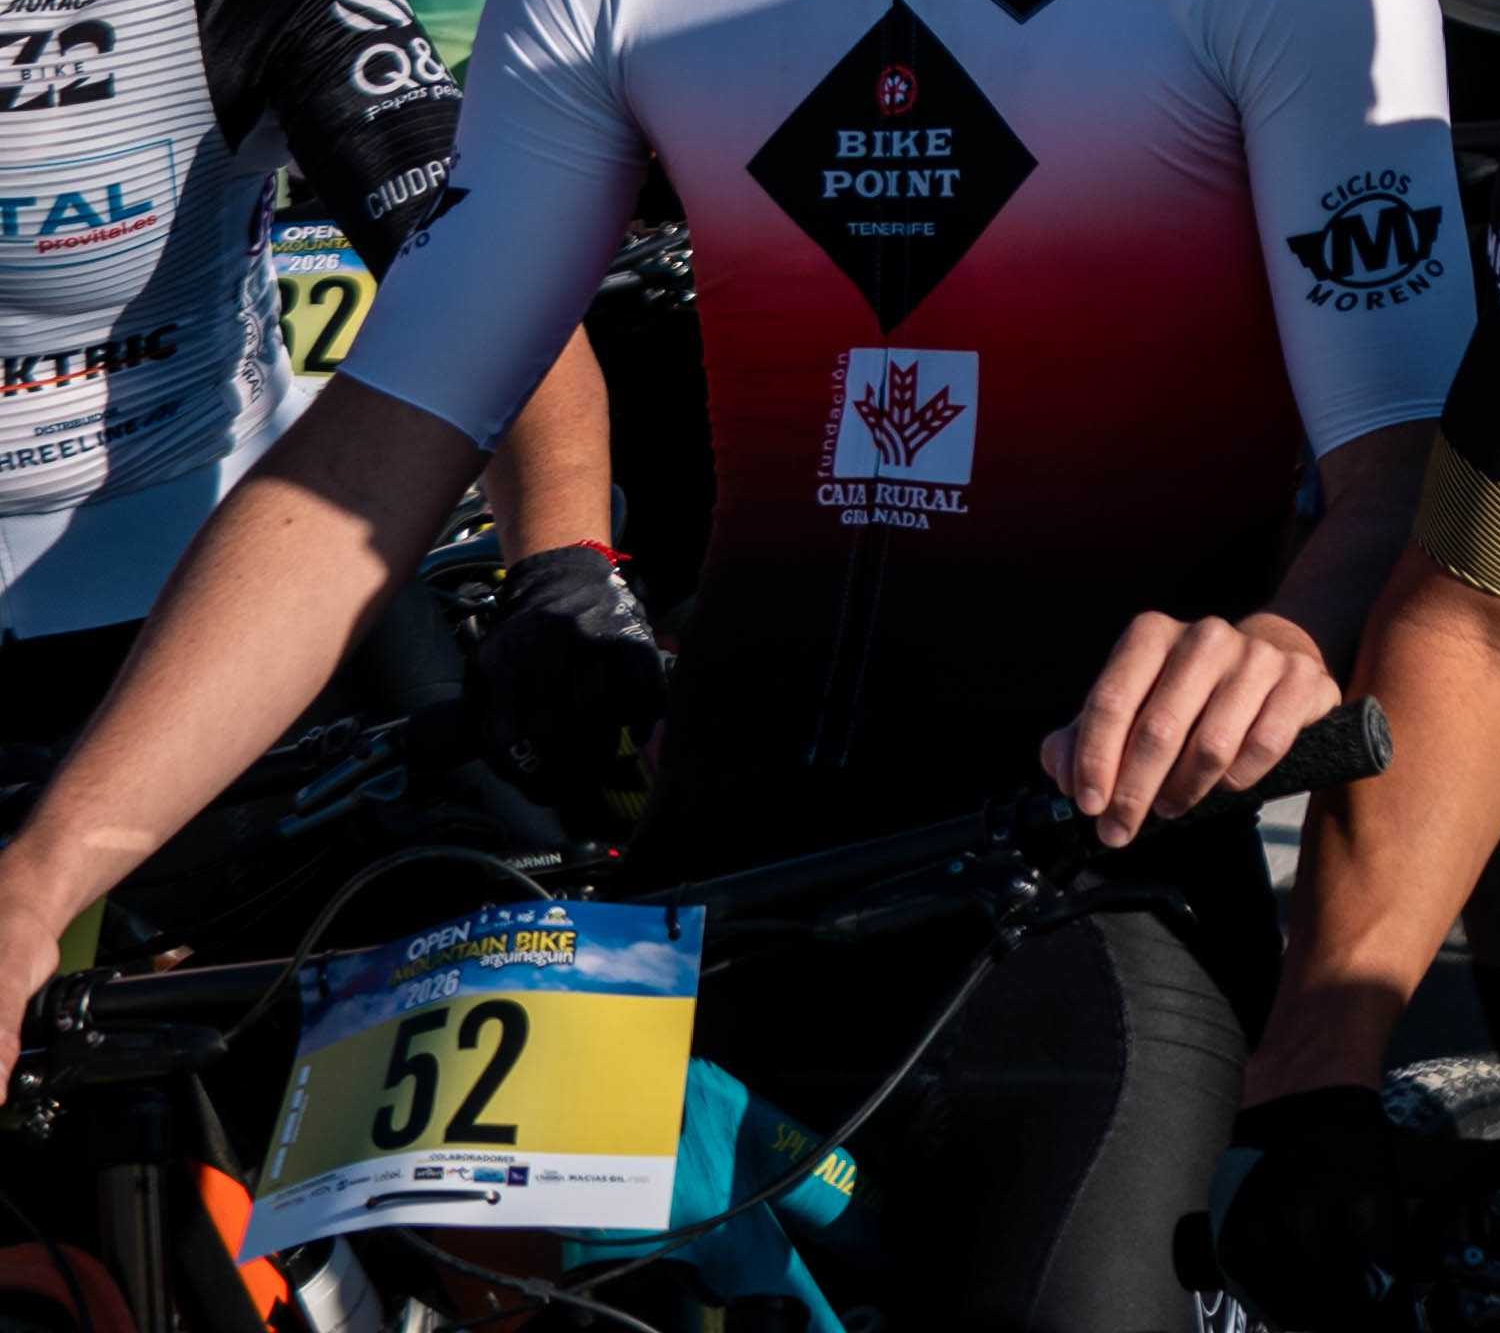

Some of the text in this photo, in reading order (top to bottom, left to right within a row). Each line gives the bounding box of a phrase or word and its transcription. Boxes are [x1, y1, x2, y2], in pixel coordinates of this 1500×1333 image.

[20, 61, 86, 82] BIKE
[835, 127, 953, 159] BIKE
[822, 167, 961, 200] POINT
[1320, 169, 1412, 215] CICLOS
[34, 212, 159, 256] provital.es
[281, 224, 345, 241] OPEN
[848, 220, 936, 238] TENERIFE
[287, 253, 341, 272] 2026
[1305, 259, 1445, 314] MORENO
[816, 350, 850, 479] fundación
[817, 482, 968, 515] CAJA RURAL
[841, 506, 931, 532] GRANADA
[406, 921, 472, 962] OPEN
[513, 929, 576, 955] BIKE
[404, 968, 462, 1010] 2026
[370, 997, 532, 1151] 52
